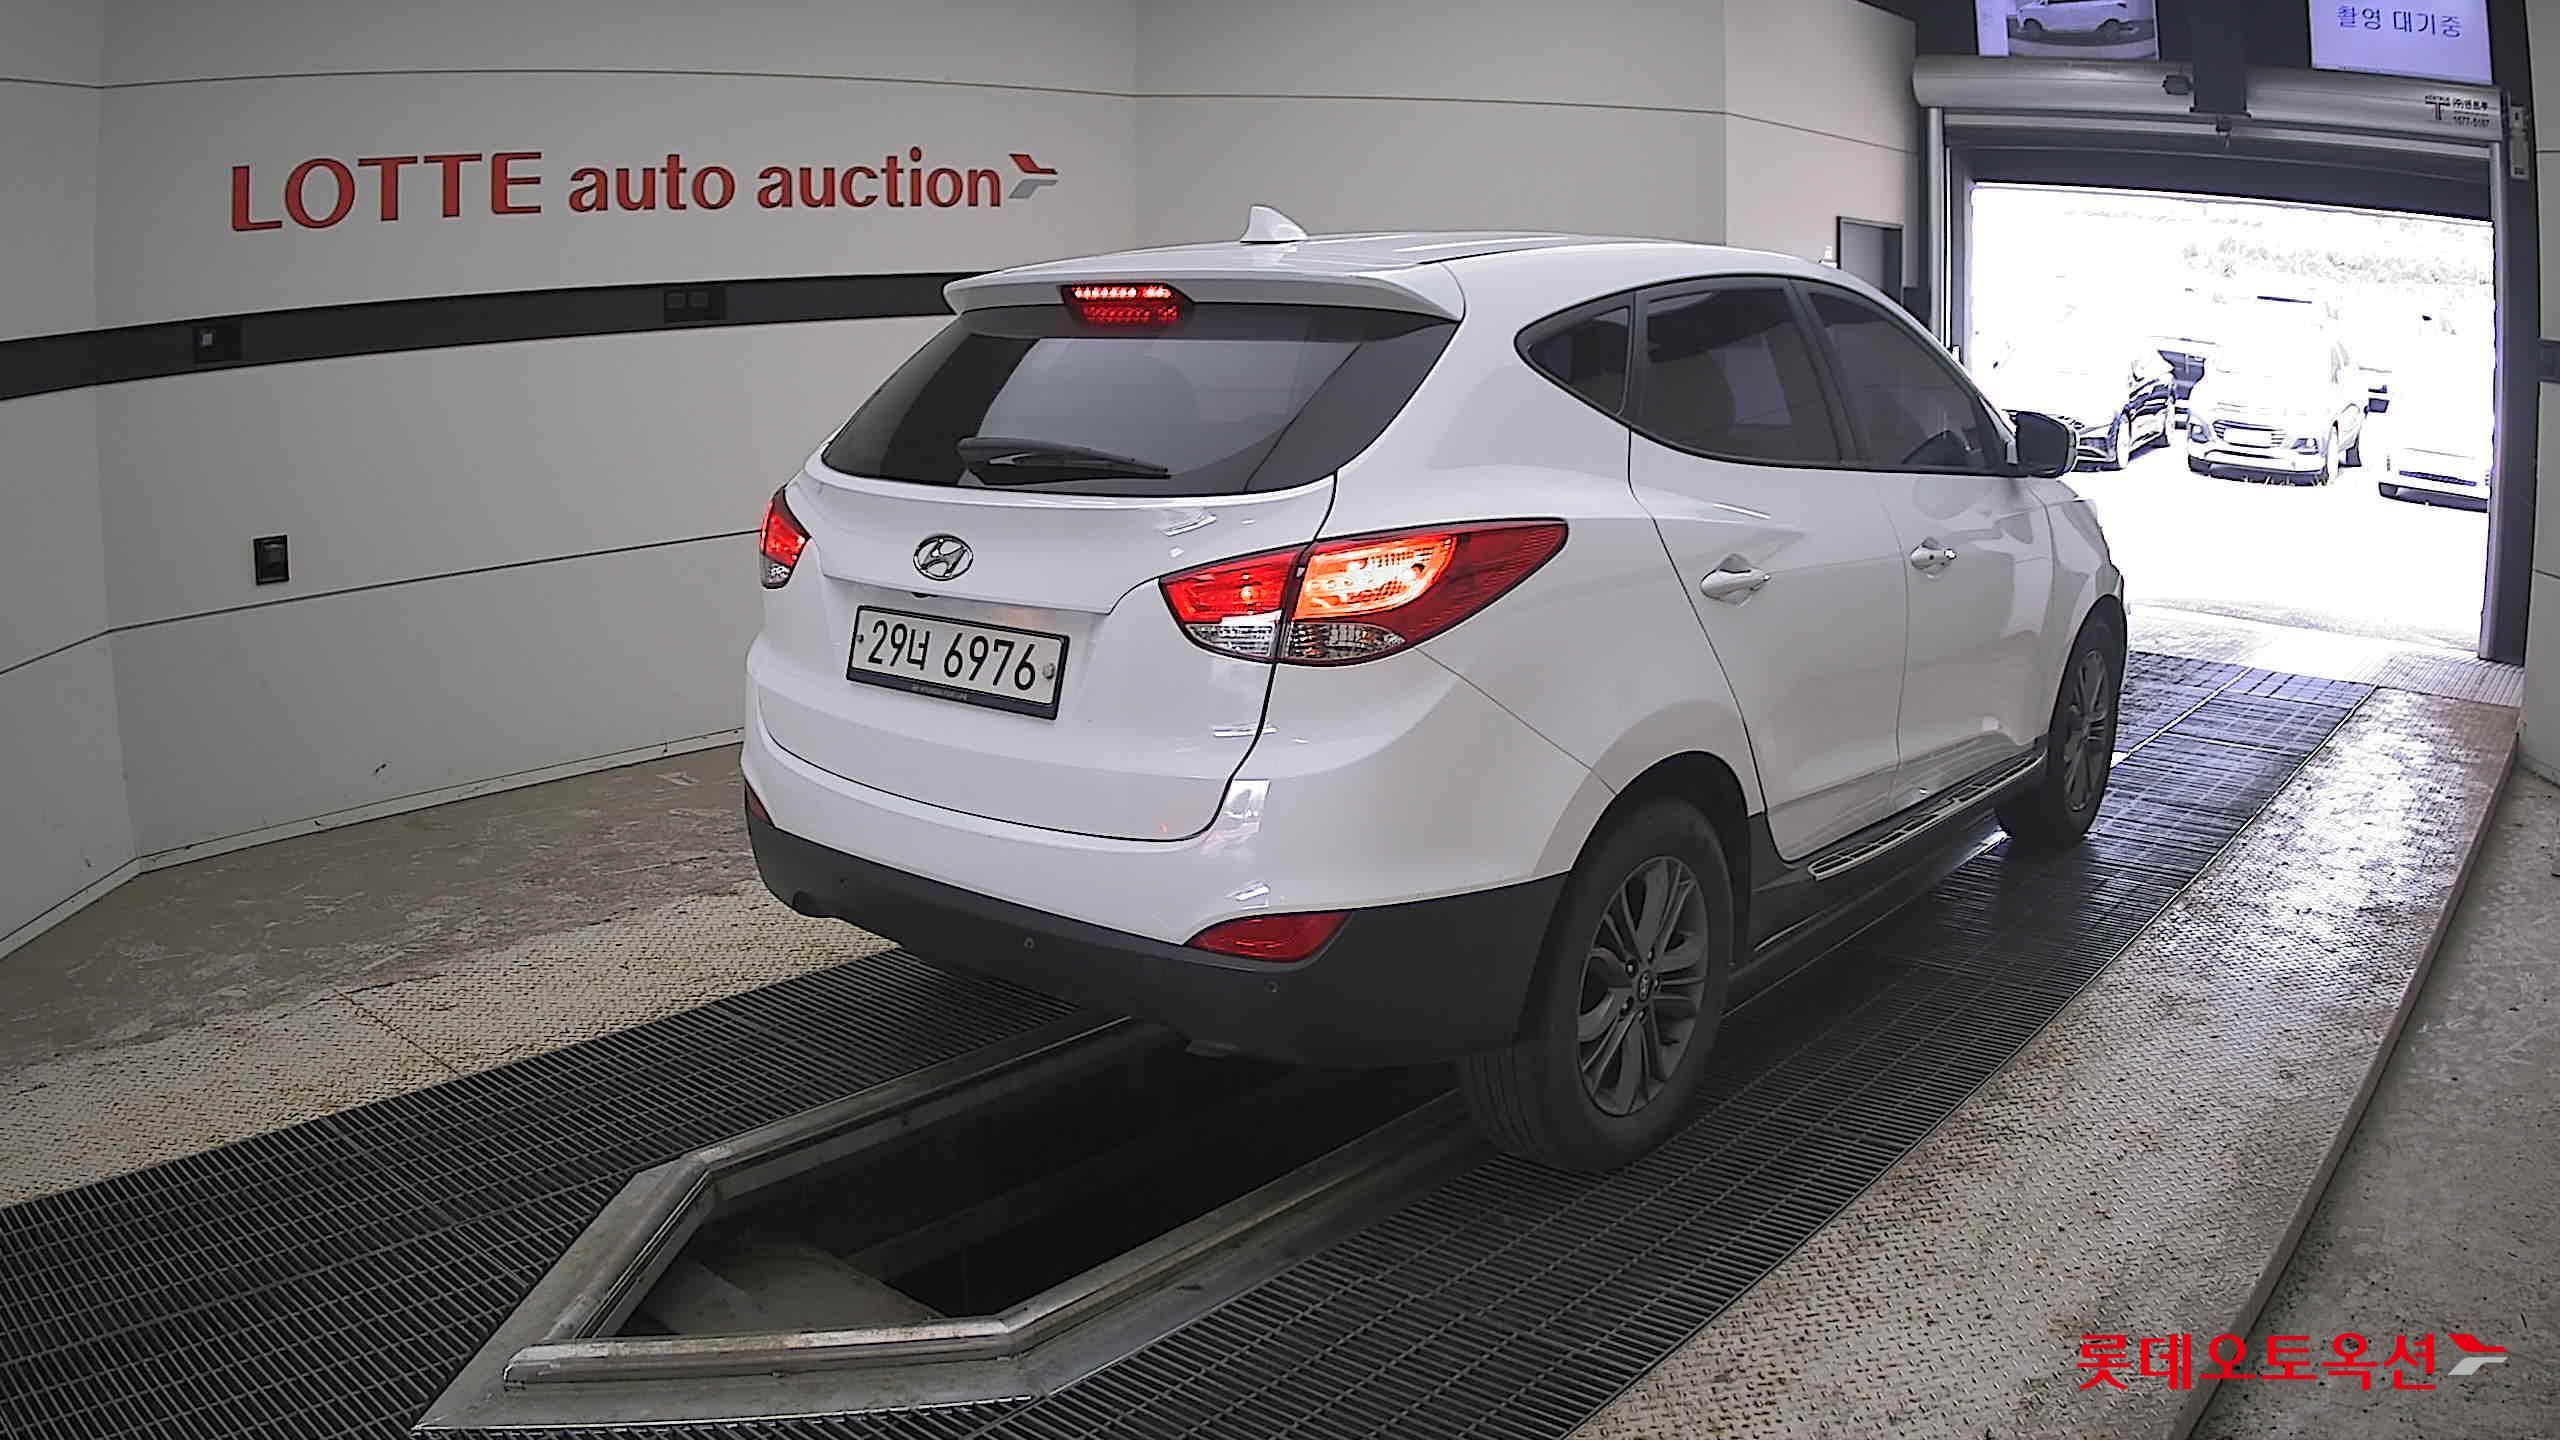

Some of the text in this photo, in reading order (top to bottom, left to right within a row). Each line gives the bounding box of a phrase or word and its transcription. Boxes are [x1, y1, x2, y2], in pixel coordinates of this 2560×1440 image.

[2392, 10, 2462, 38] 대기중
[231, 146, 1002, 232] LOTTE auto auction
[867, 619, 1037, 691] 29너 6976
